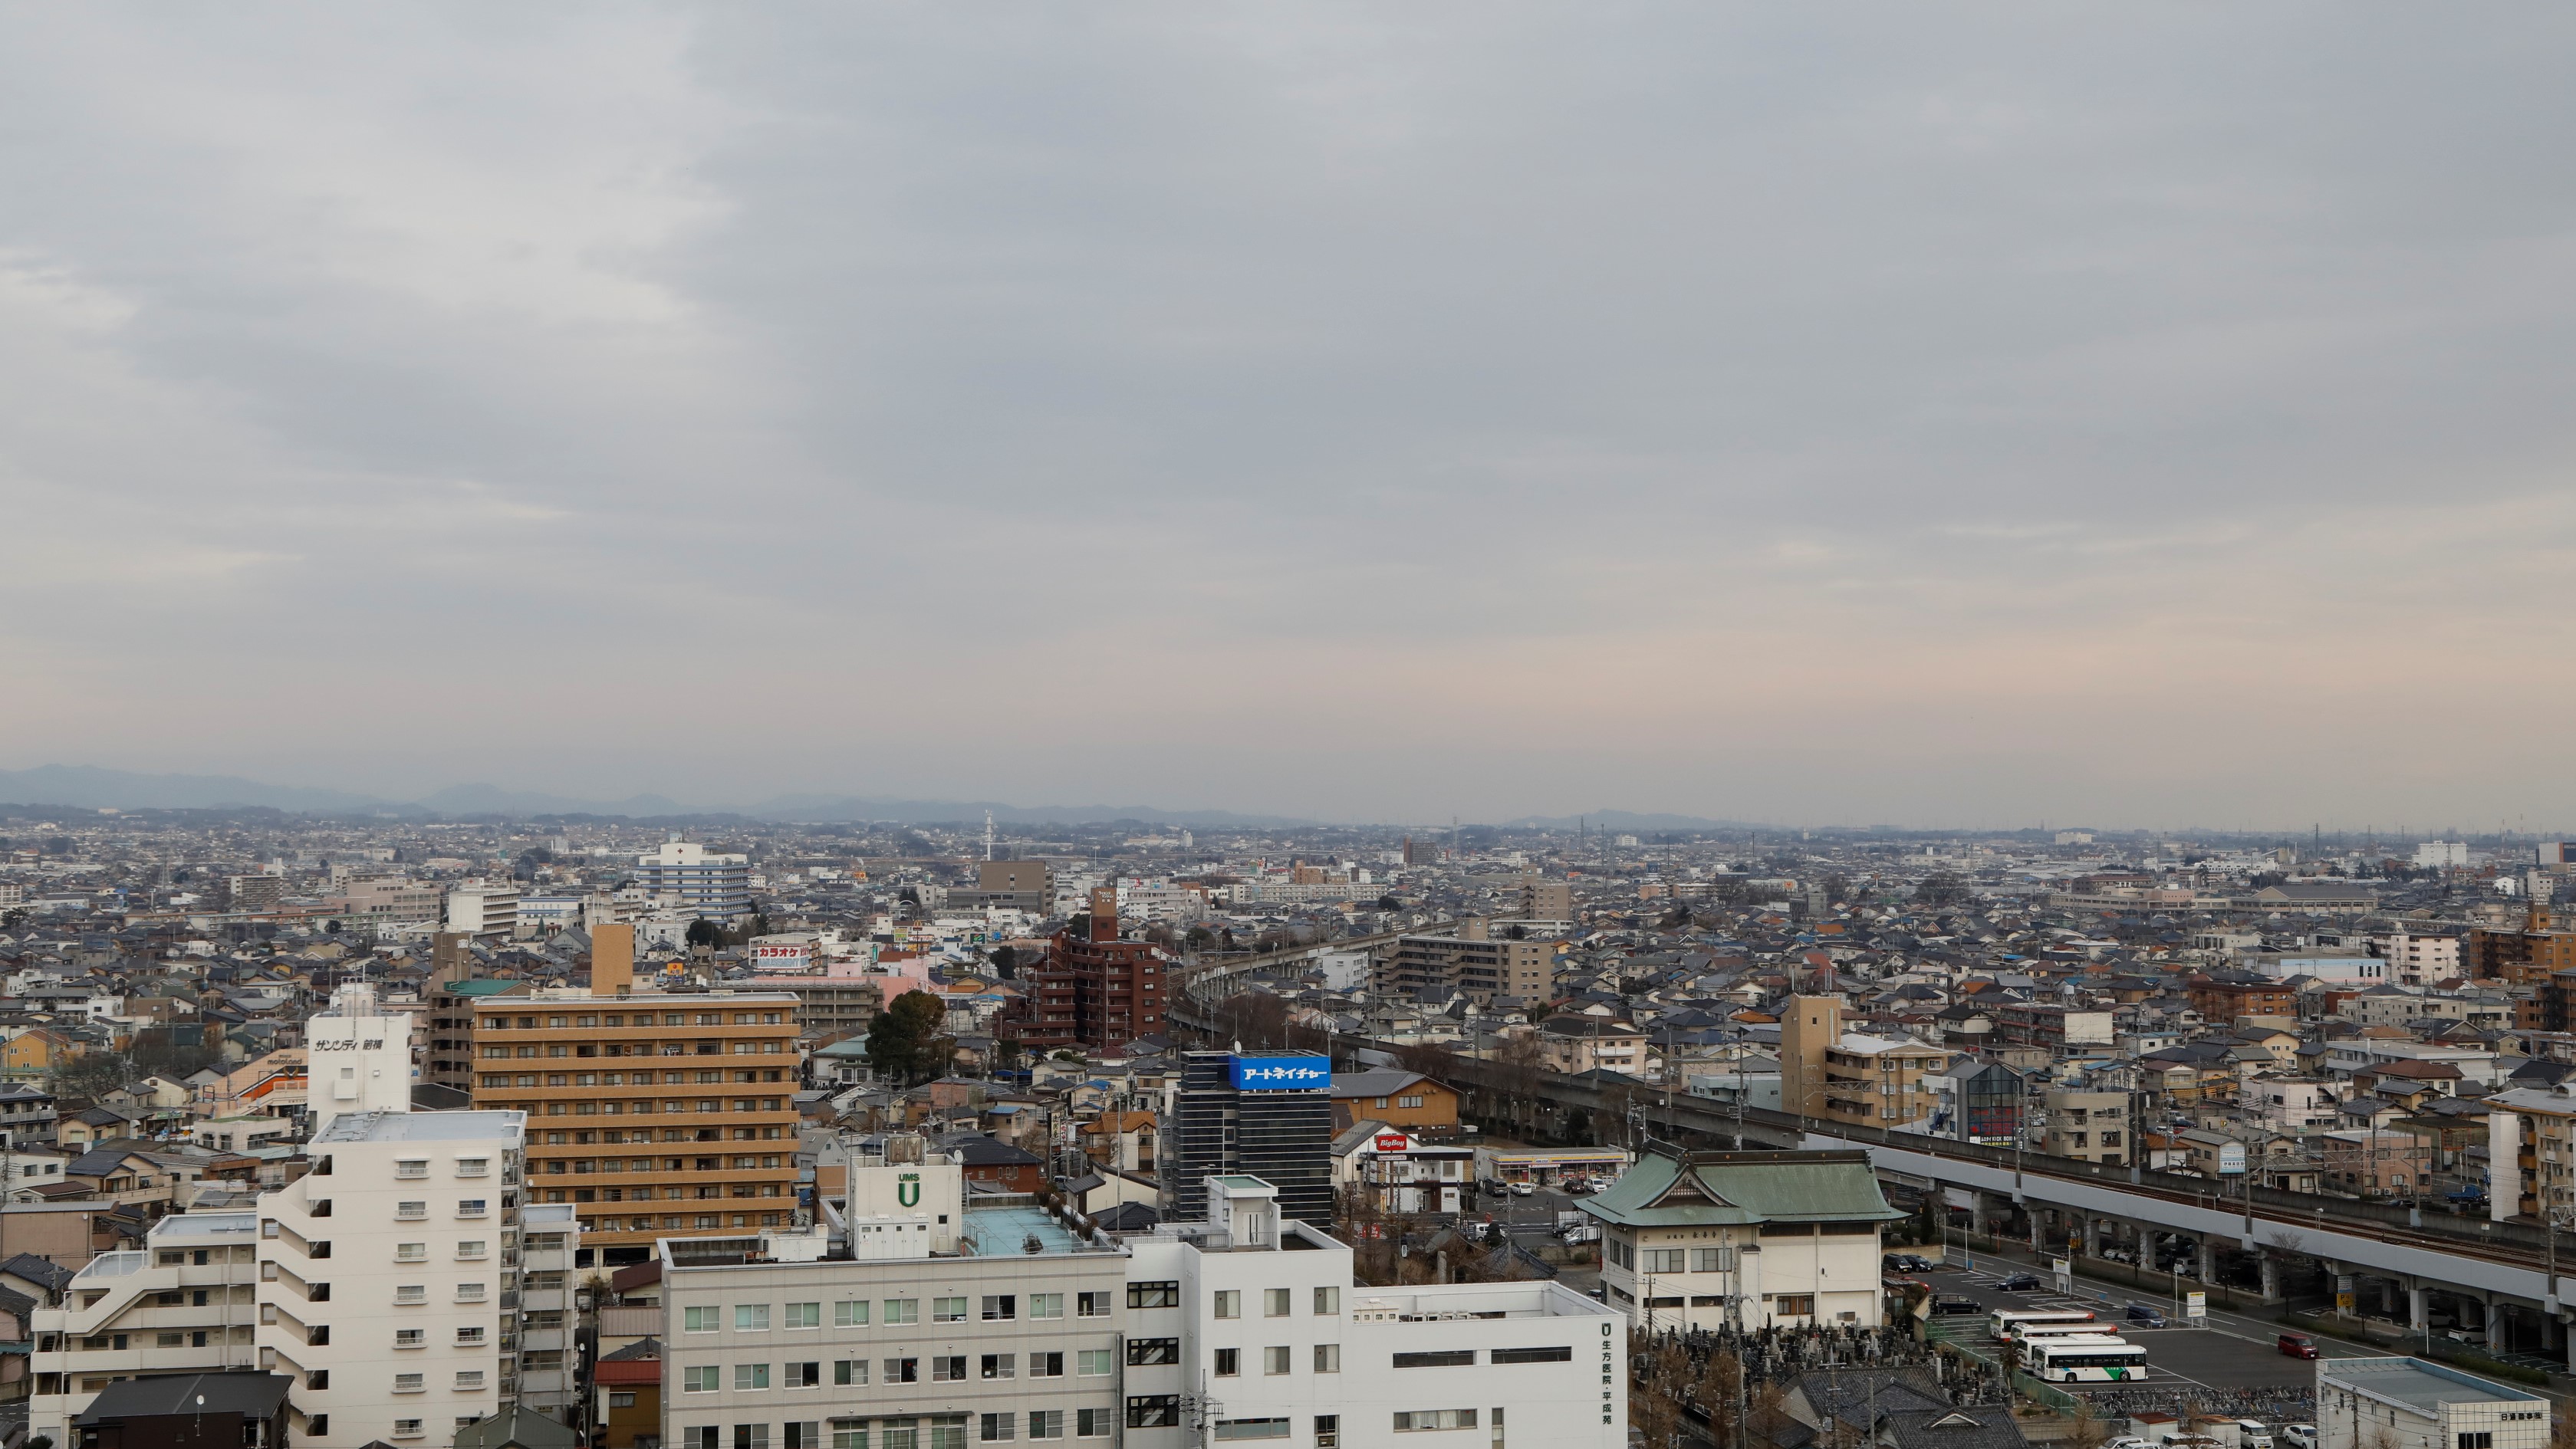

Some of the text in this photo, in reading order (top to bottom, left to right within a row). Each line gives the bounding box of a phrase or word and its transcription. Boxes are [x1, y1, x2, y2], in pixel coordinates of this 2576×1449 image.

[759, 948, 798, 958] カラオケ
[758, 958, 799, 968] AMUSEMENT
[314, 1039, 383, 1052] サンシティ 前橋
[1243, 1066, 1327, 1080] アートネイチャー
[898, 1173, 920, 1181] UMS
[1602, 1340, 1612, 1425] 生方医院・平成苑
